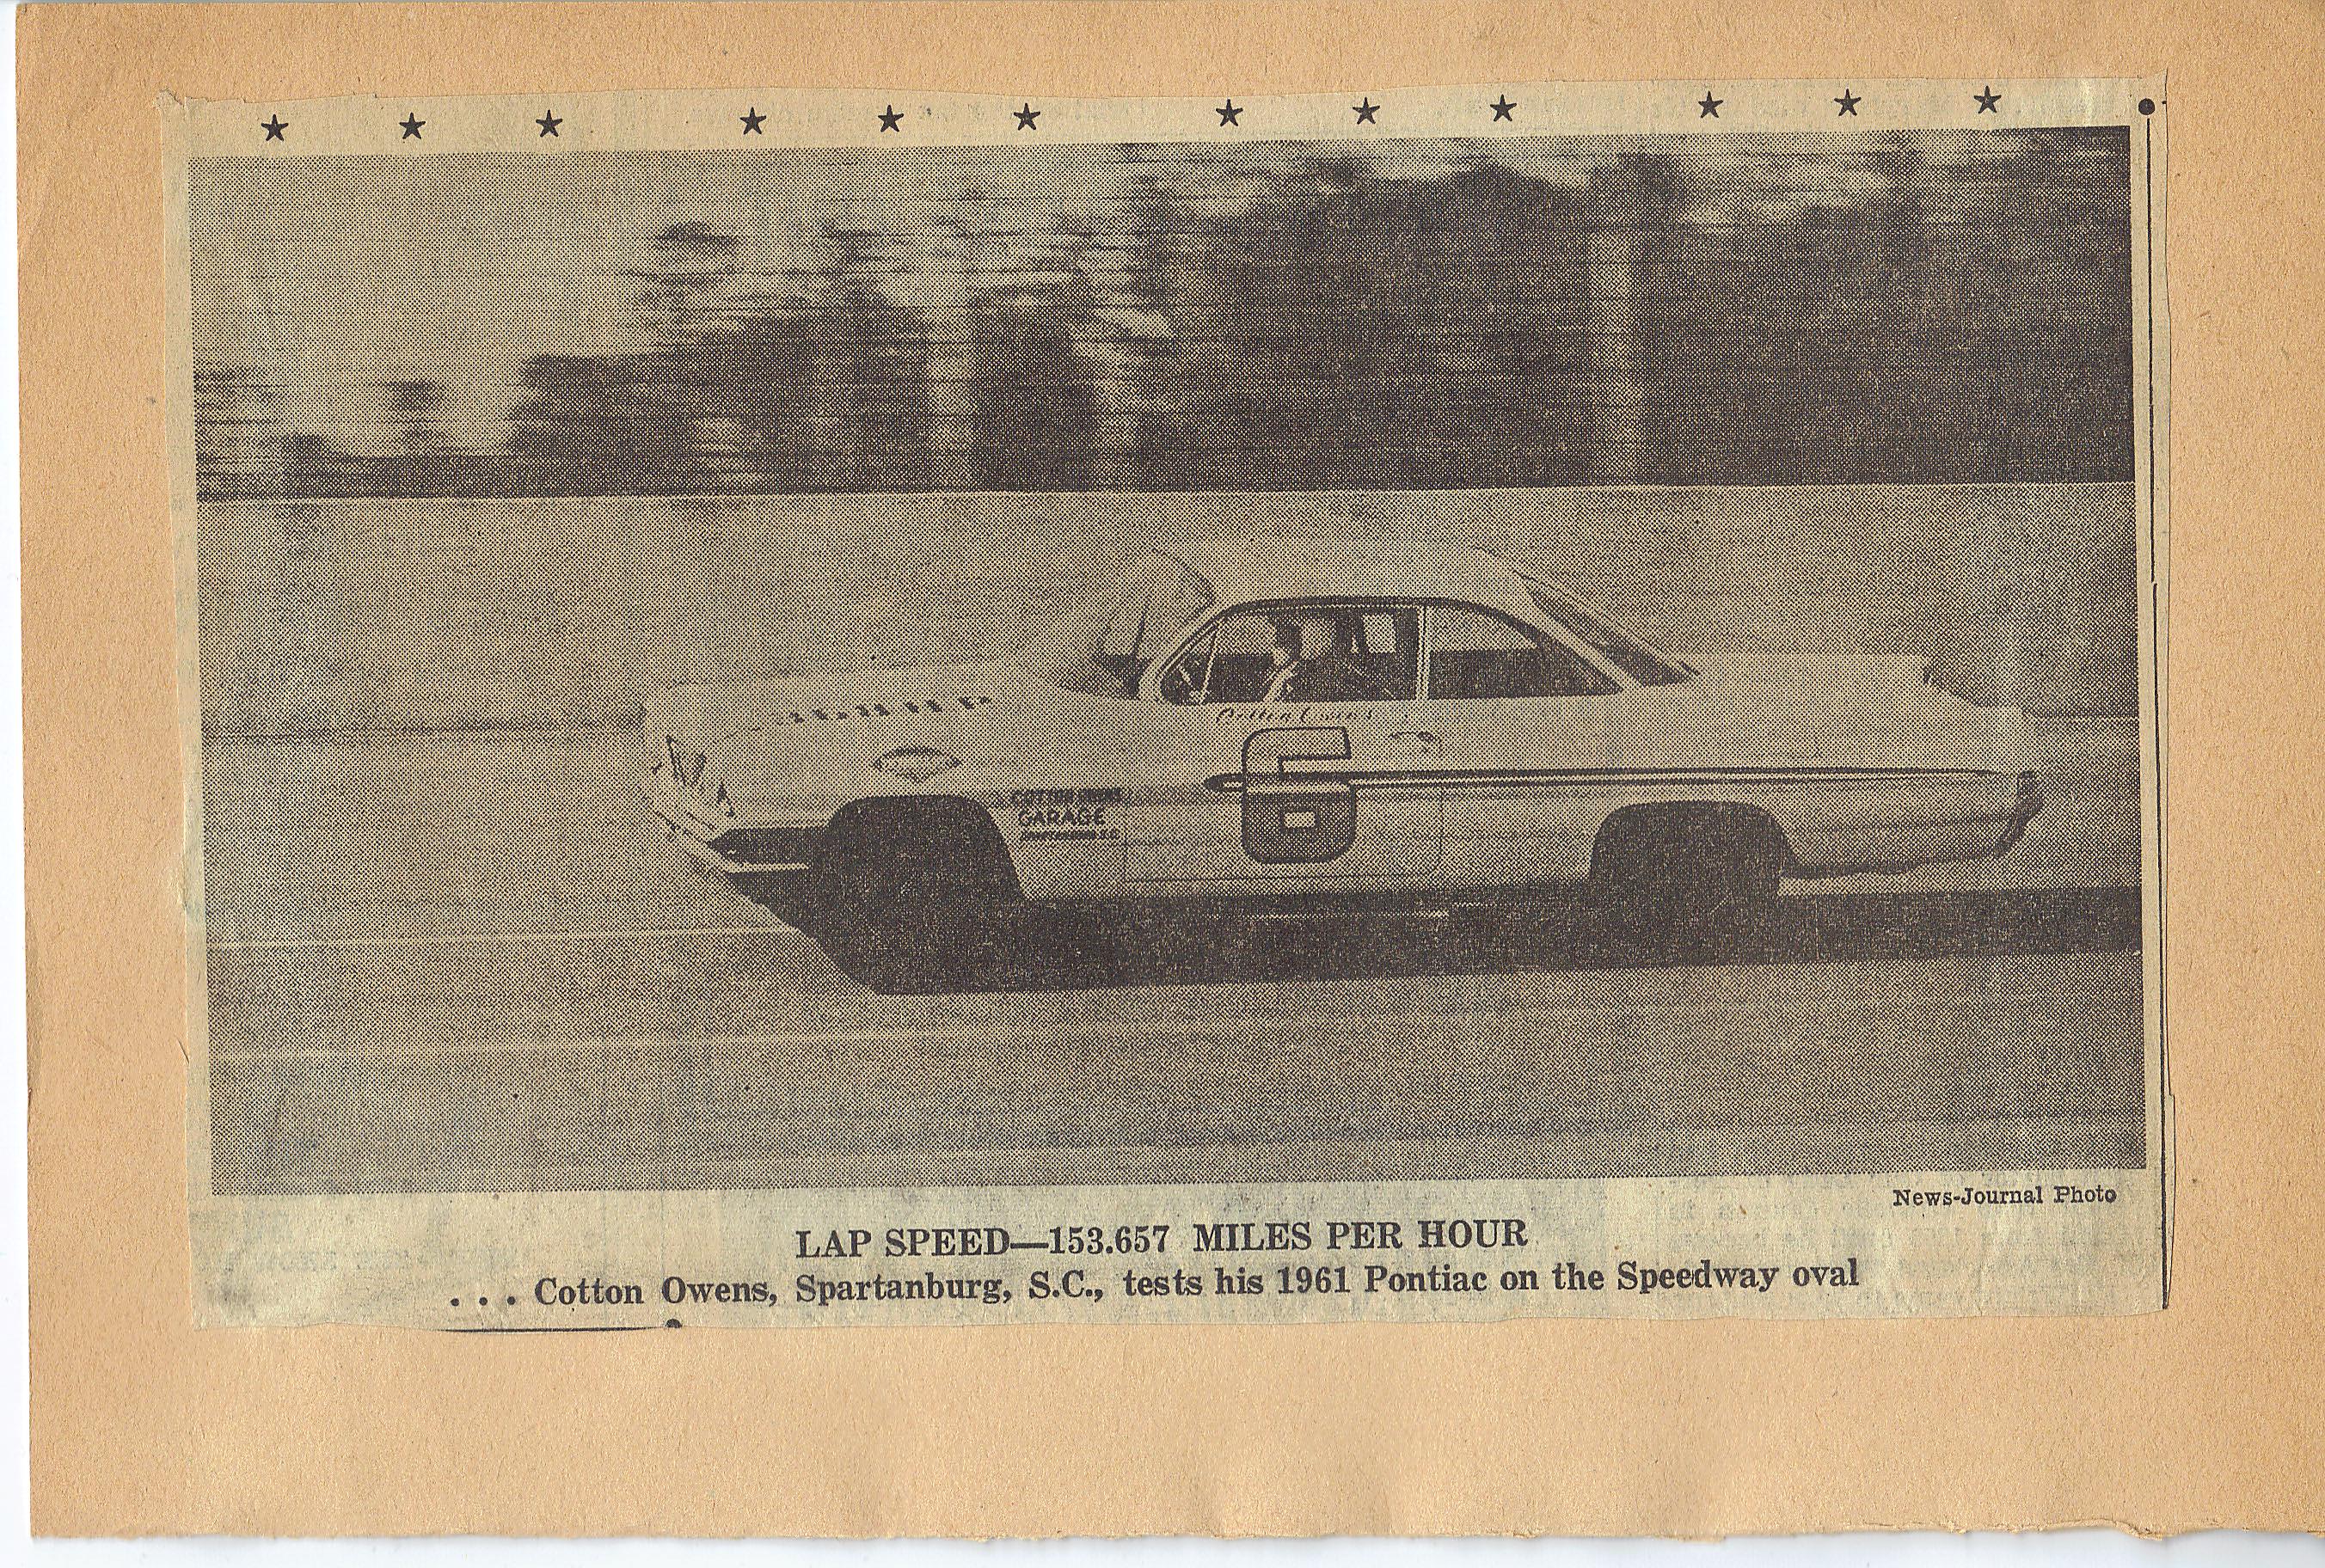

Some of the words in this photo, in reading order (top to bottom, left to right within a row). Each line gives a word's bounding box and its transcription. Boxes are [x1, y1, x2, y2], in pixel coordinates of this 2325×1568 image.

[1242, 726, 1356, 863] 6
[1018, 806, 1106, 827] GARAGE
[1893, 1186, 2043, 1206] News-Journal
[2053, 1184, 2118, 1204] Photo
[795, 1229, 872, 1259] LAP
[1193, 1221, 1312, 1253] MILES
[1325, 1221, 1403, 1251] PER
[1417, 1218, 1529, 1249] HOUR
[534, 1277, 645, 1306] Cotton
[661, 1276, 777, 1308] Owens,
[796, 1271, 1012, 1307] Spartanburg,
[1028, 1269, 1104, 1303] S.C.,
[1122, 1267, 1203, 1296] tests
[1214, 1266, 1264, 1295] his
[1277, 1265, 1351, 1295] 1961
[1364, 1263, 1488, 1293] Pontiac
[1500, 1270, 1540, 1291] on
[1551, 1261, 1604, 1291] the
[1617, 1259, 1780, 1295] Speedway
[1792, 1257, 1860, 1287] oval
